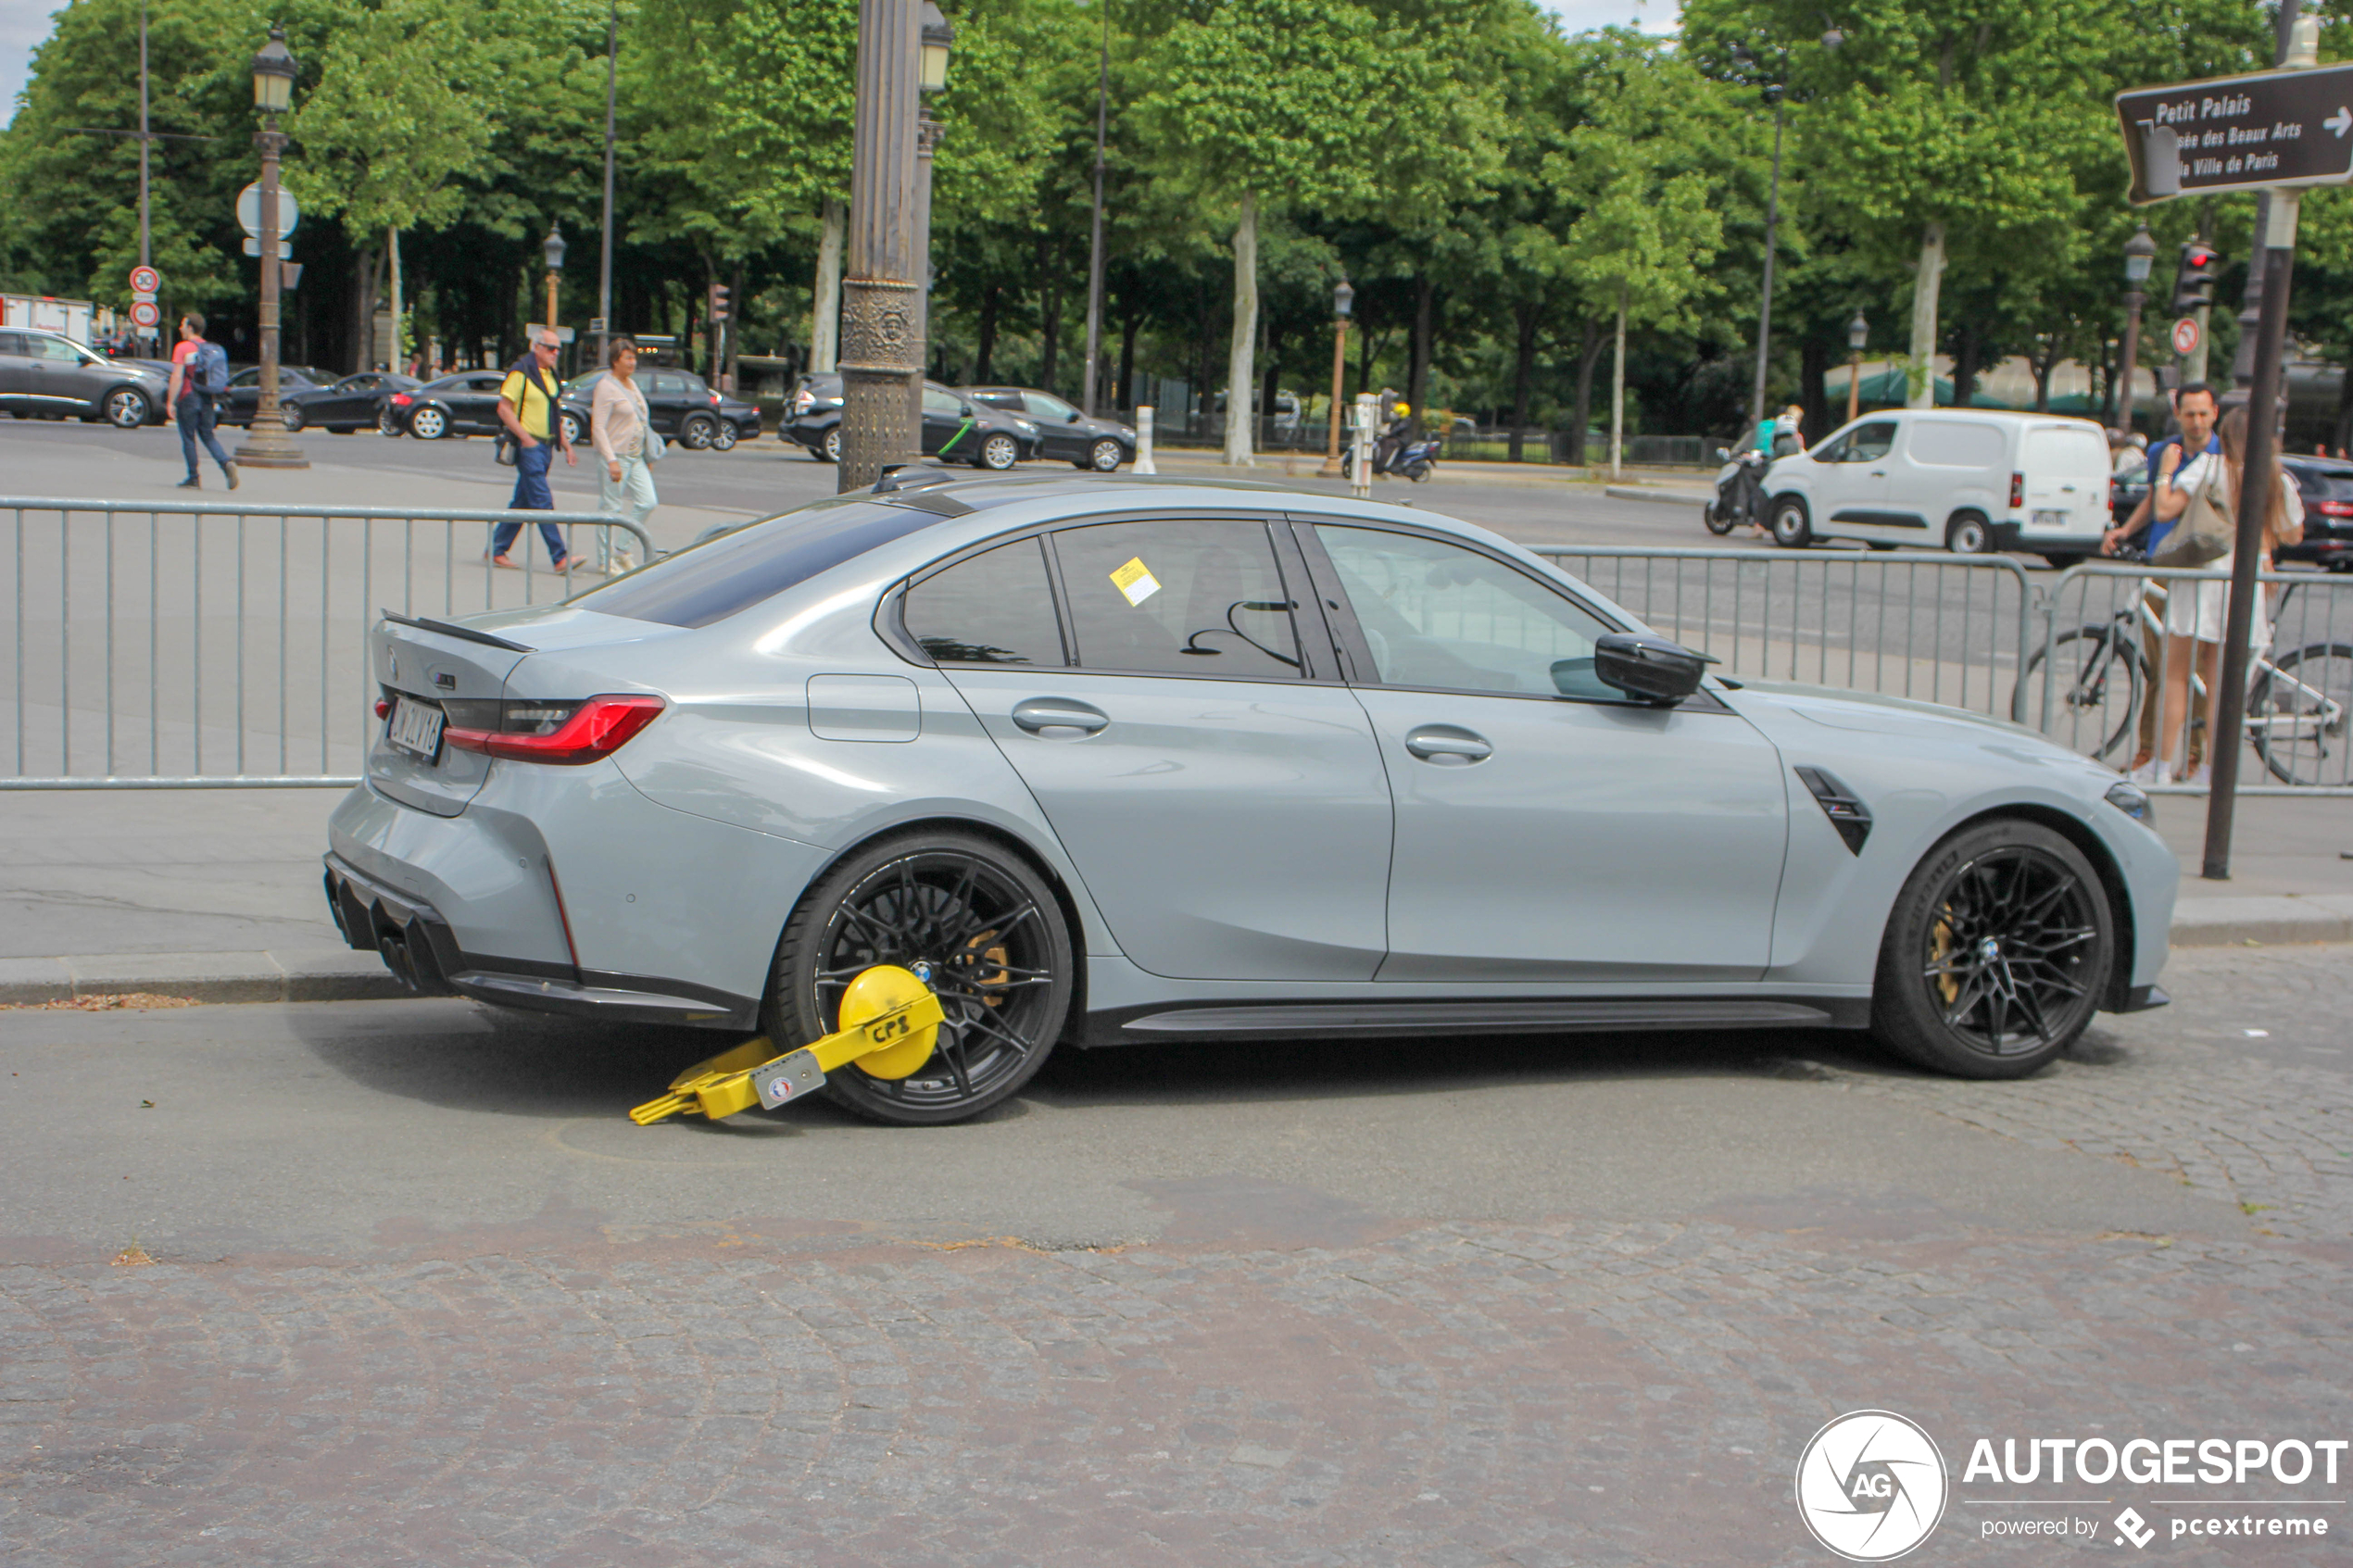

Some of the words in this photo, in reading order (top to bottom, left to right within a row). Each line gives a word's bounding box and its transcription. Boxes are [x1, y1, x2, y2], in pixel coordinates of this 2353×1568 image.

[2156, 100, 2196, 124] Petit
[2200, 94, 2251, 119] Palais
[2177, 132, 2198, 149] sée
[2202, 130, 2224, 148] des
[2227, 126, 2268, 145] Beaux
[2271, 121, 2302, 141] Arts
[2194, 157, 2222, 176] Ville
[2226, 155, 2243, 173] de
[2245, 151, 2279, 171] Paris
[136, 274, 152, 285] 30
